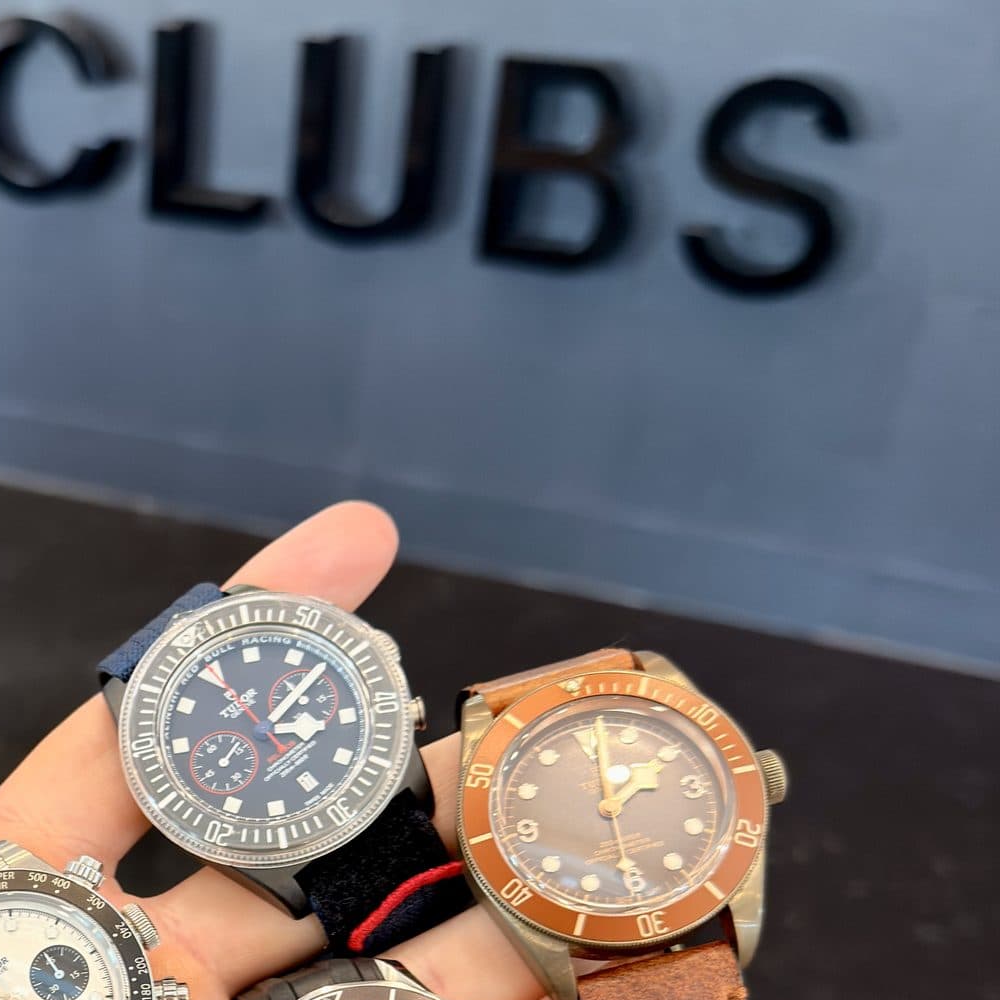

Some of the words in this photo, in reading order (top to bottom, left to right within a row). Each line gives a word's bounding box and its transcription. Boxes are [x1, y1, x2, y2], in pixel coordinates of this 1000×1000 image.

[292, 606, 321, 629] 50
[181, 664, 200, 686] RED
[203, 643, 237, 663] BULL
[241, 635, 292, 646] RACING
[374, 691, 399, 714] 40
[694, 703, 720, 727] 10
[132, 739, 152, 758] 10
[466, 763, 493, 789] 50
[679, 774, 708, 799] 3
[326, 798, 357, 827] 30
[204, 820, 234, 846] 20
[516, 819, 540, 843] 9
[733, 818, 761, 848] 20
[27, 872, 47, 883] 500
[52, 876, 71, 890] 400
[622, 865, 648, 893] 6
[86, 894, 105, 910] 300
[500, 877, 532, 907] 40
[114, 921, 132, 939] 240
[636, 911, 670, 938] 30
[134, 956, 148, 975] 200
[140, 983, 151, 1000] 180
